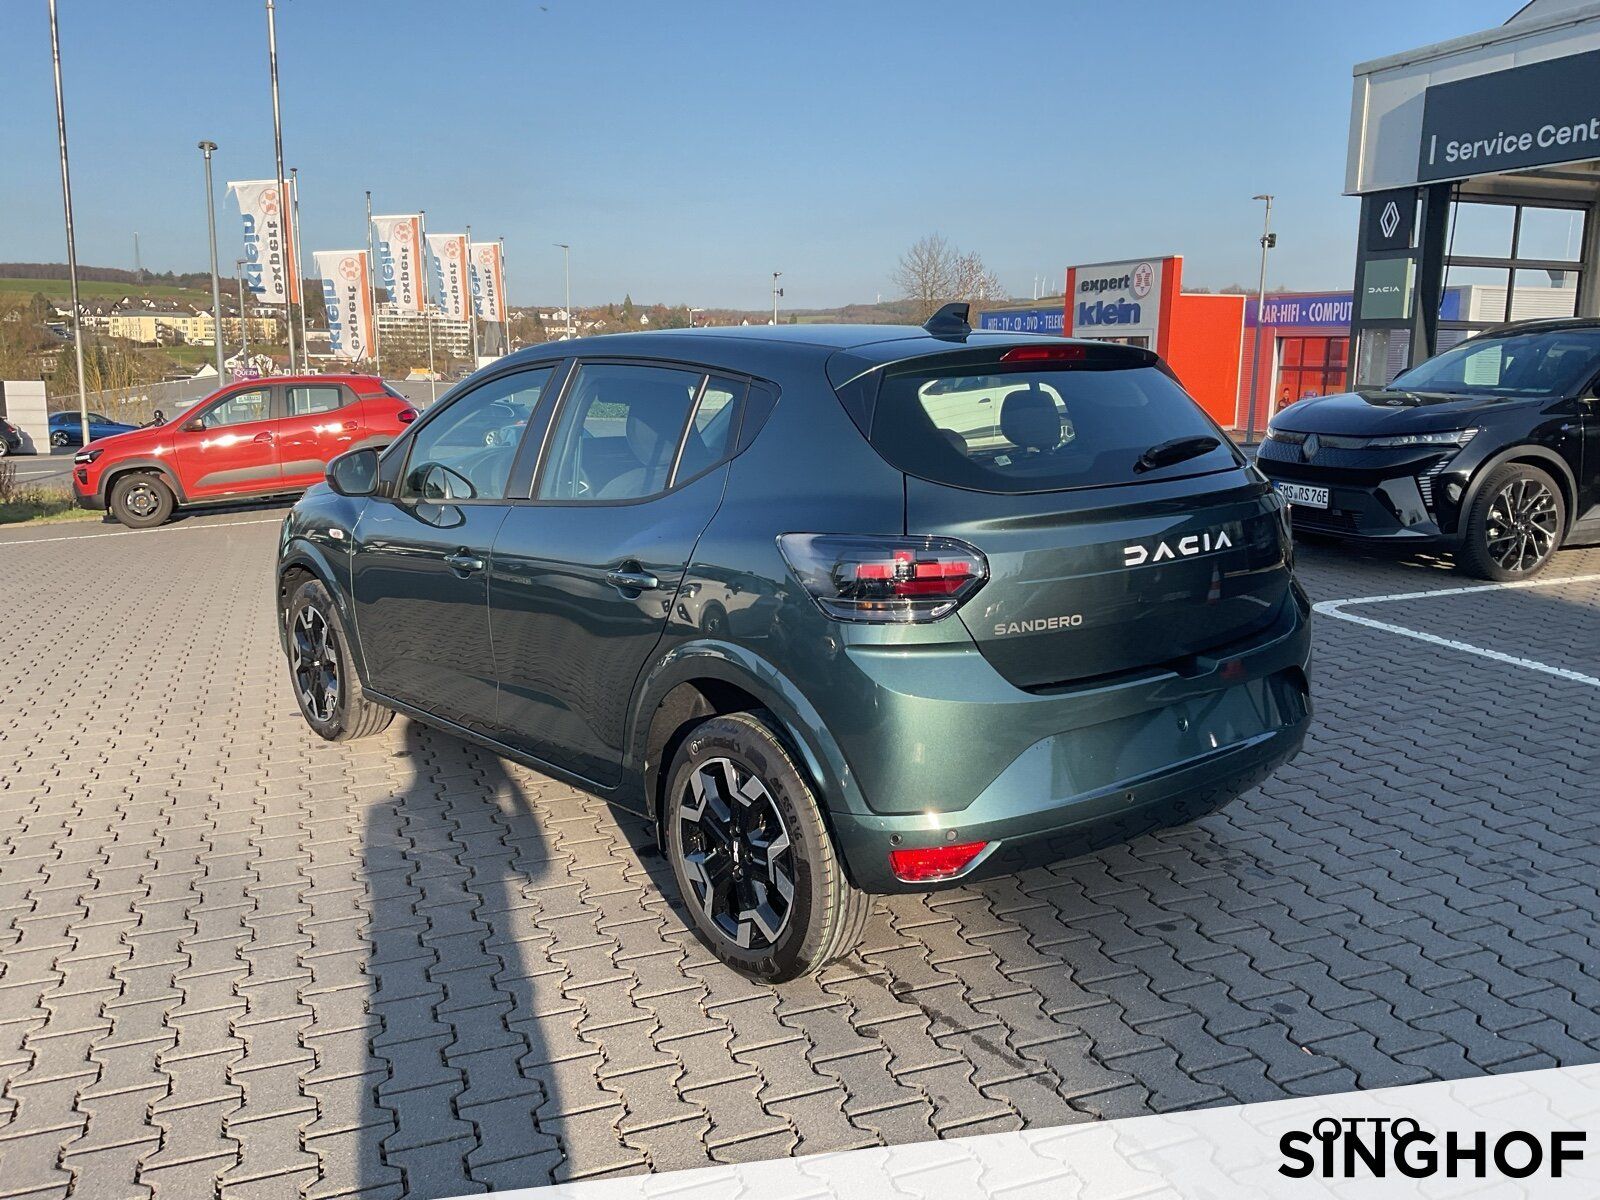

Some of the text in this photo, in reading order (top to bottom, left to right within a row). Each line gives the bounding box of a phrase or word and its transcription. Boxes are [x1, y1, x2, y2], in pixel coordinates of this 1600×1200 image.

[1445, 132, 1533, 162] Service
[1080, 274, 1131, 293] expert
[1368, 285, 1400, 294] DACIA
[1078, 297, 1141, 326] klein
[1124, 530, 1233, 567] DACIA
[994, 614, 1083, 636] SANDERO
